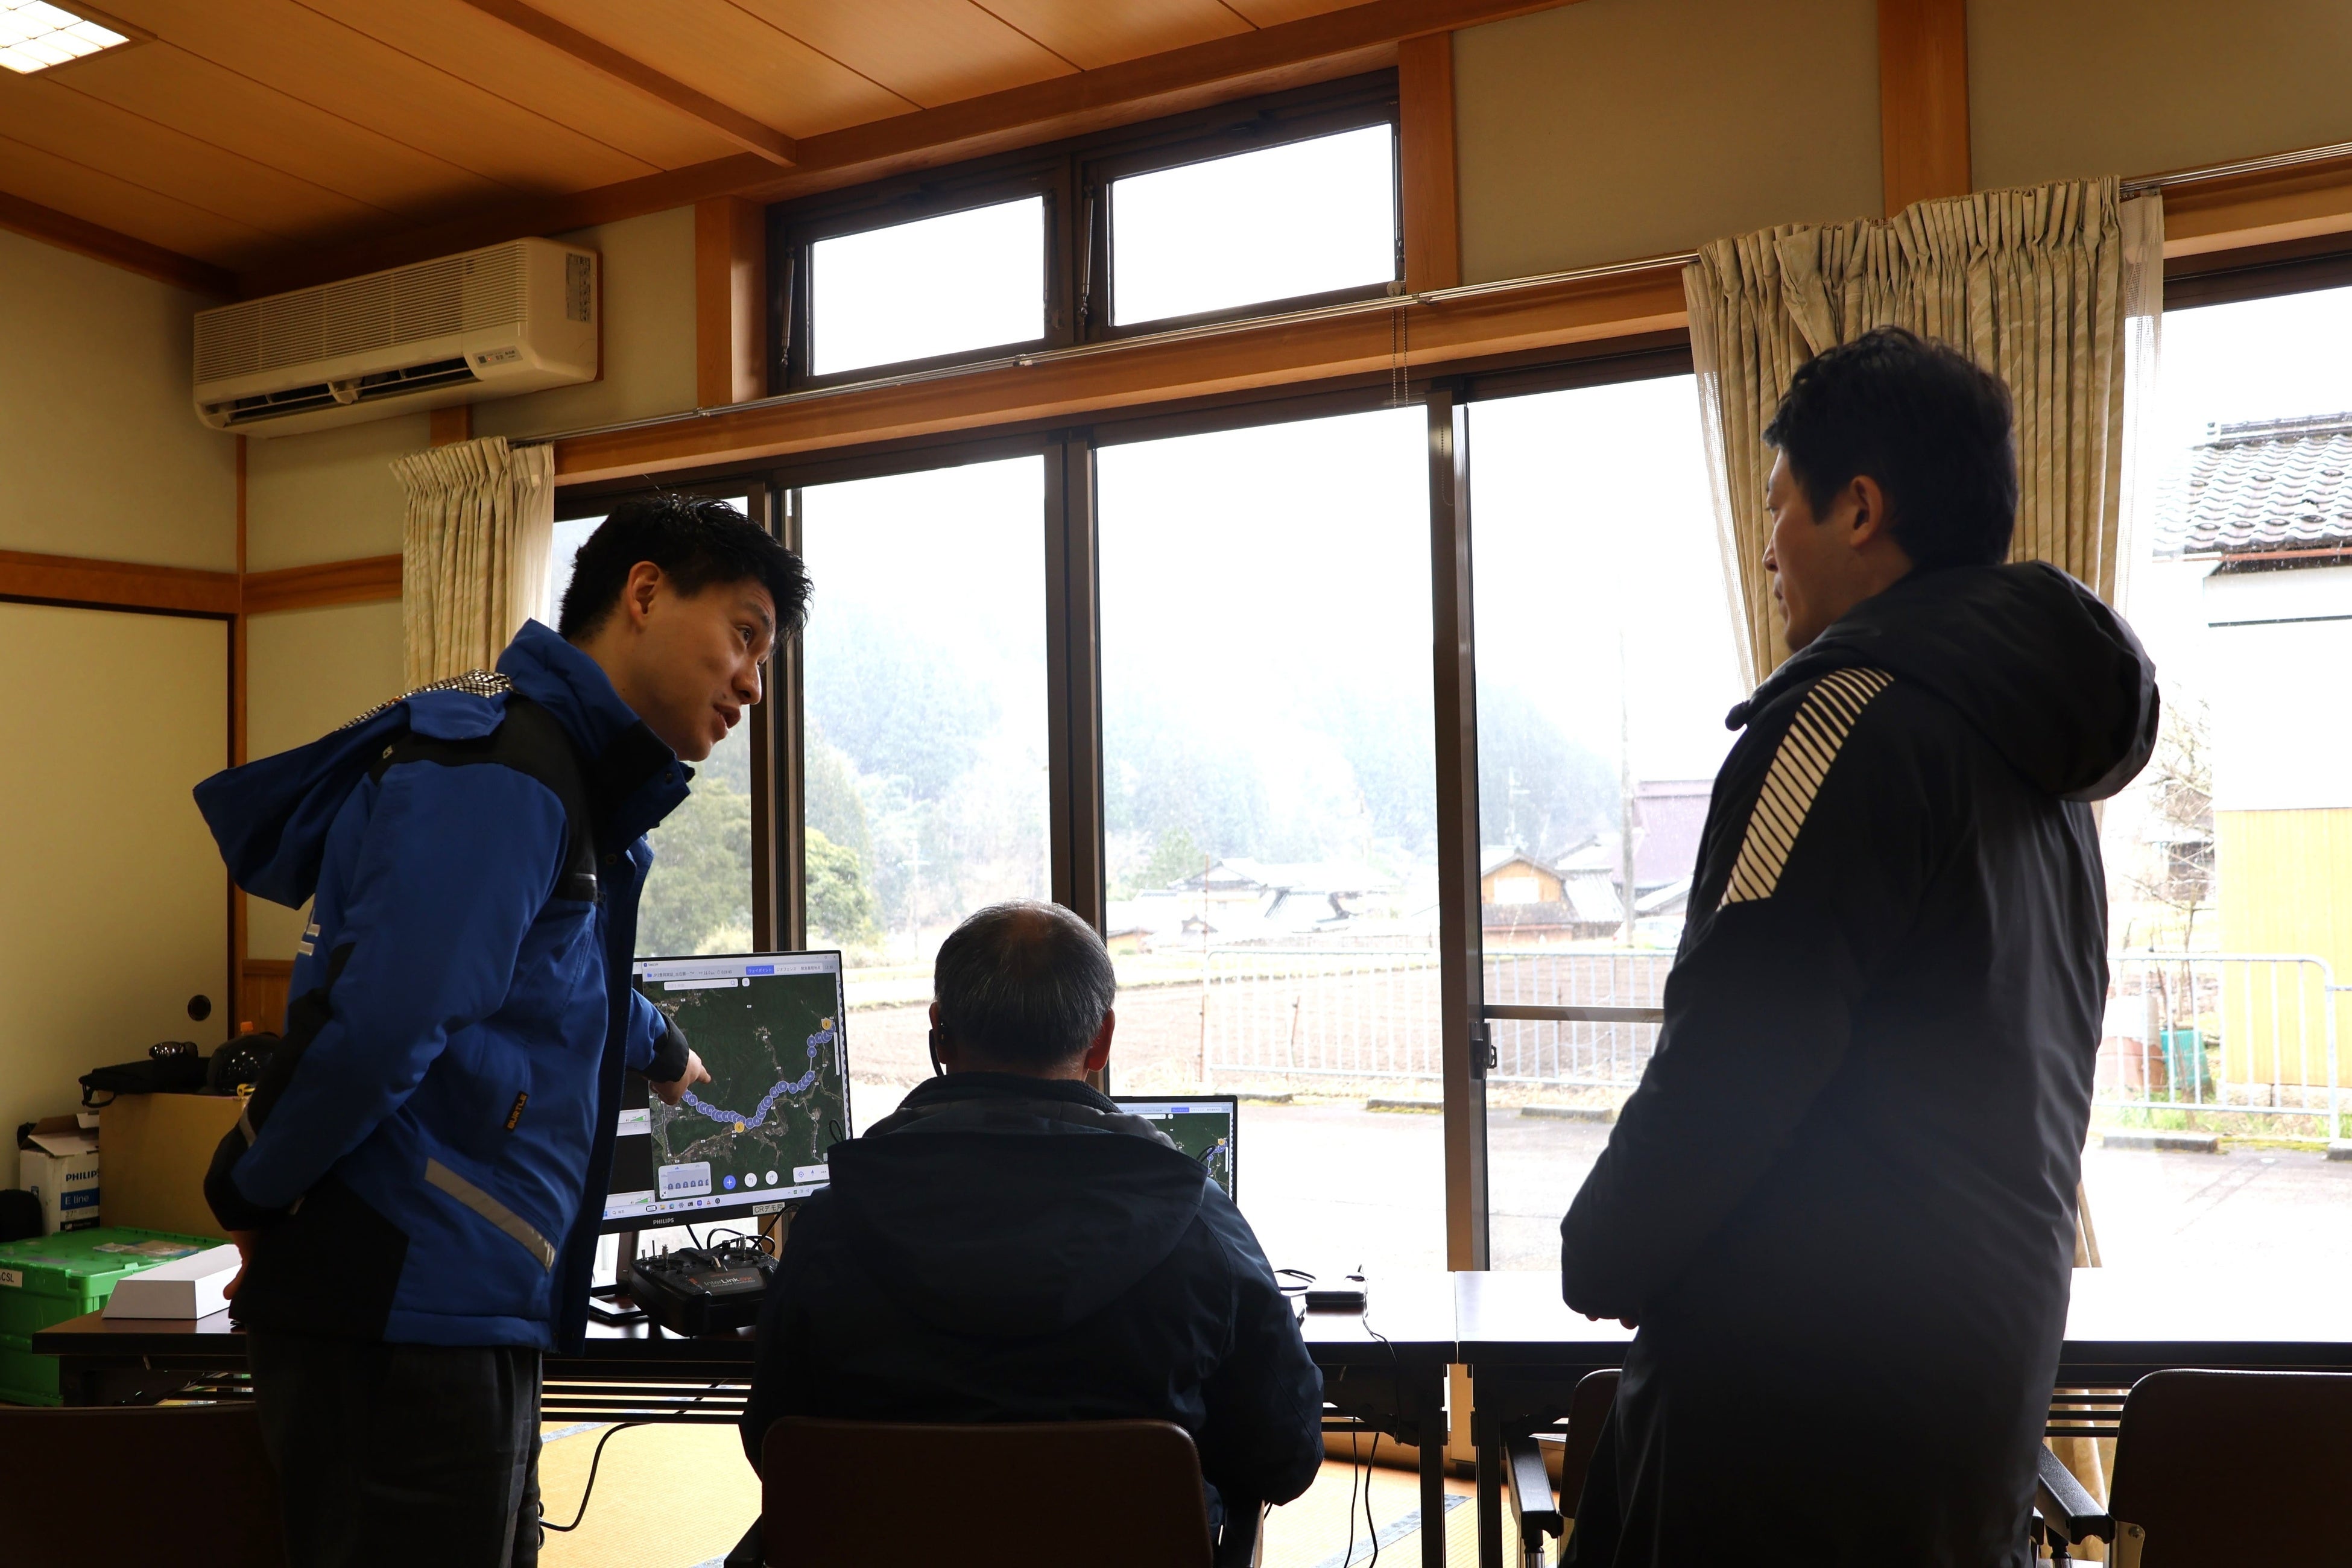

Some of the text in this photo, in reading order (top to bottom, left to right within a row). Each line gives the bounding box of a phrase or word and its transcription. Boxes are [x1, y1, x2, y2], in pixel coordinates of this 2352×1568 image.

[507, 1093, 528, 1130] BURTLE
[65, 1195, 90, 1205] E line
[754, 1203, 783, 1213] CRデモ用
[0, 1272, 14, 1283] CSL
